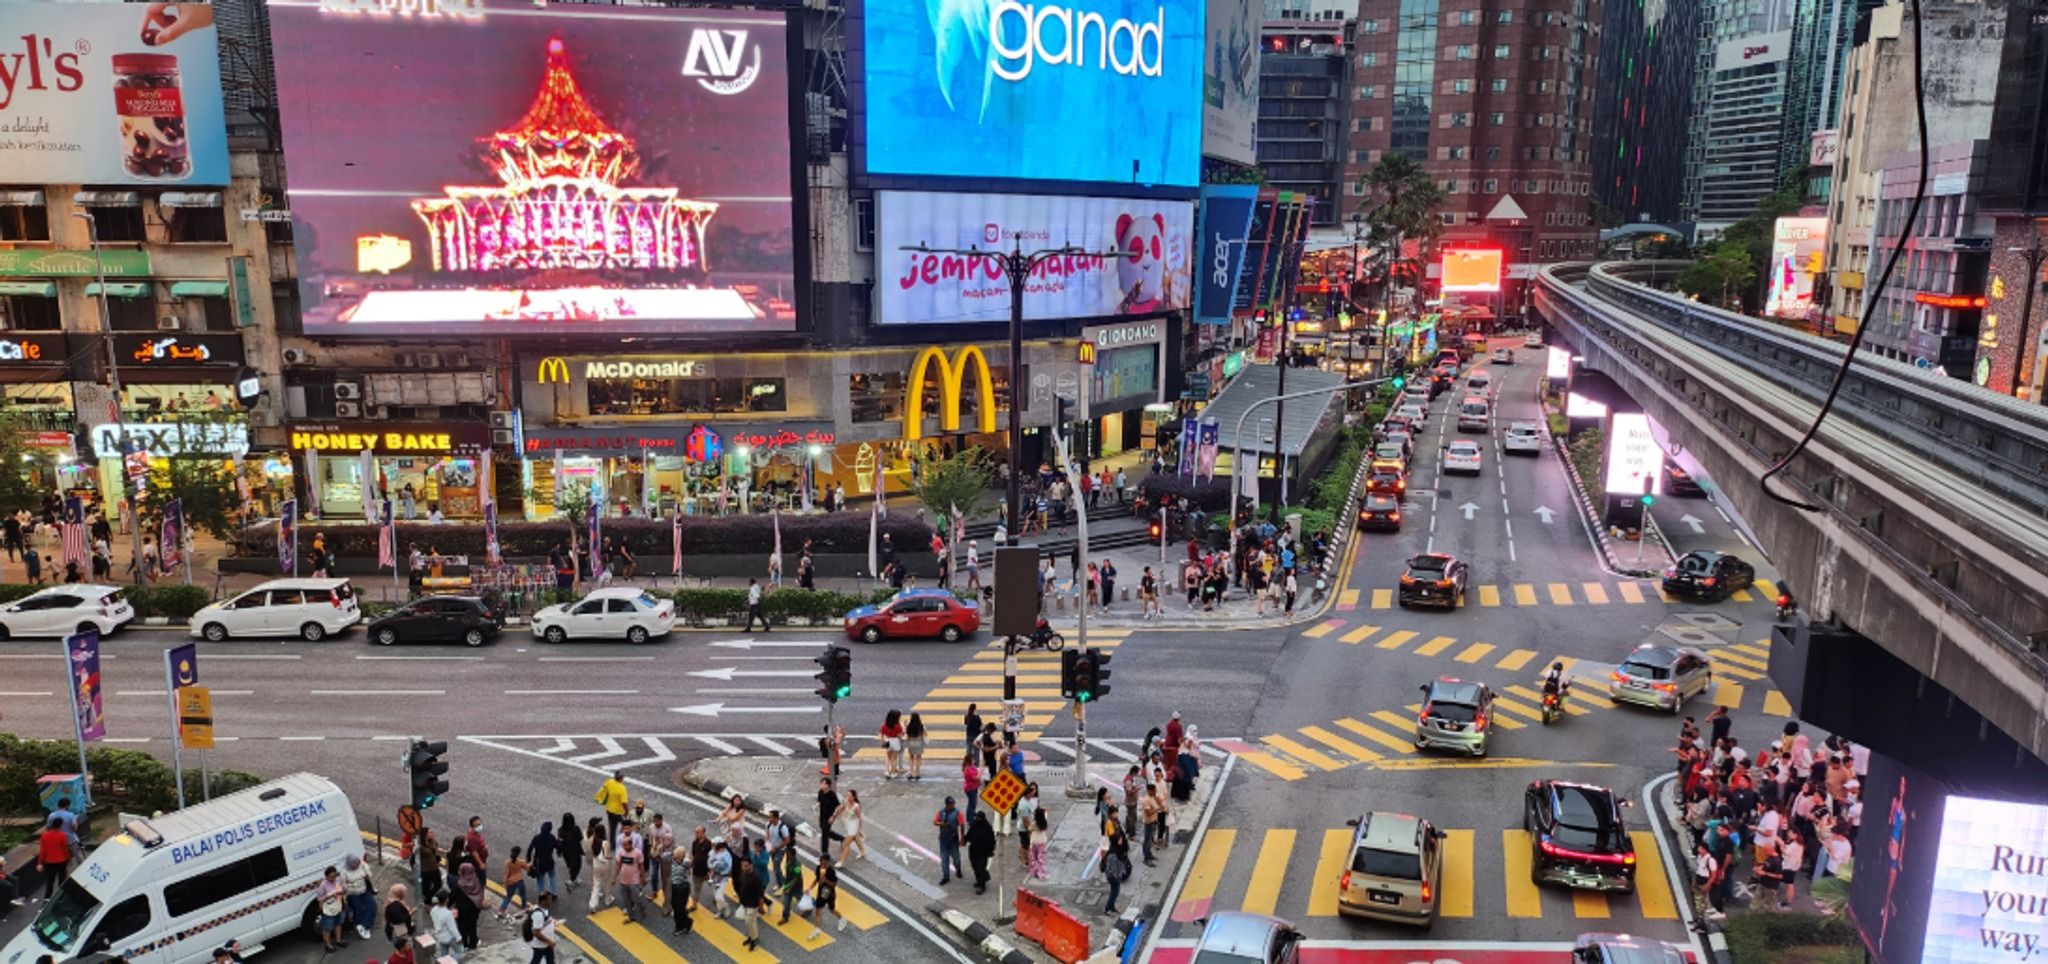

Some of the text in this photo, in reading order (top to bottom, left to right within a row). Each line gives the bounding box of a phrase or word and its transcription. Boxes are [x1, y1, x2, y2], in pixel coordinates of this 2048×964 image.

[989, 0, 1164, 80] ganad
[29, 259, 91, 274] Shuttle
[1214, 232, 1229, 288] acer
[1098, 325, 1157, 346] GIORDANO
[585, 360, 706, 379] McDonald's
[292, 431, 451, 450] HONEY BAKE
[171, 800, 327, 864] BALAI POLIS BERGERAK
[1979, 927, 2041, 962] way.
